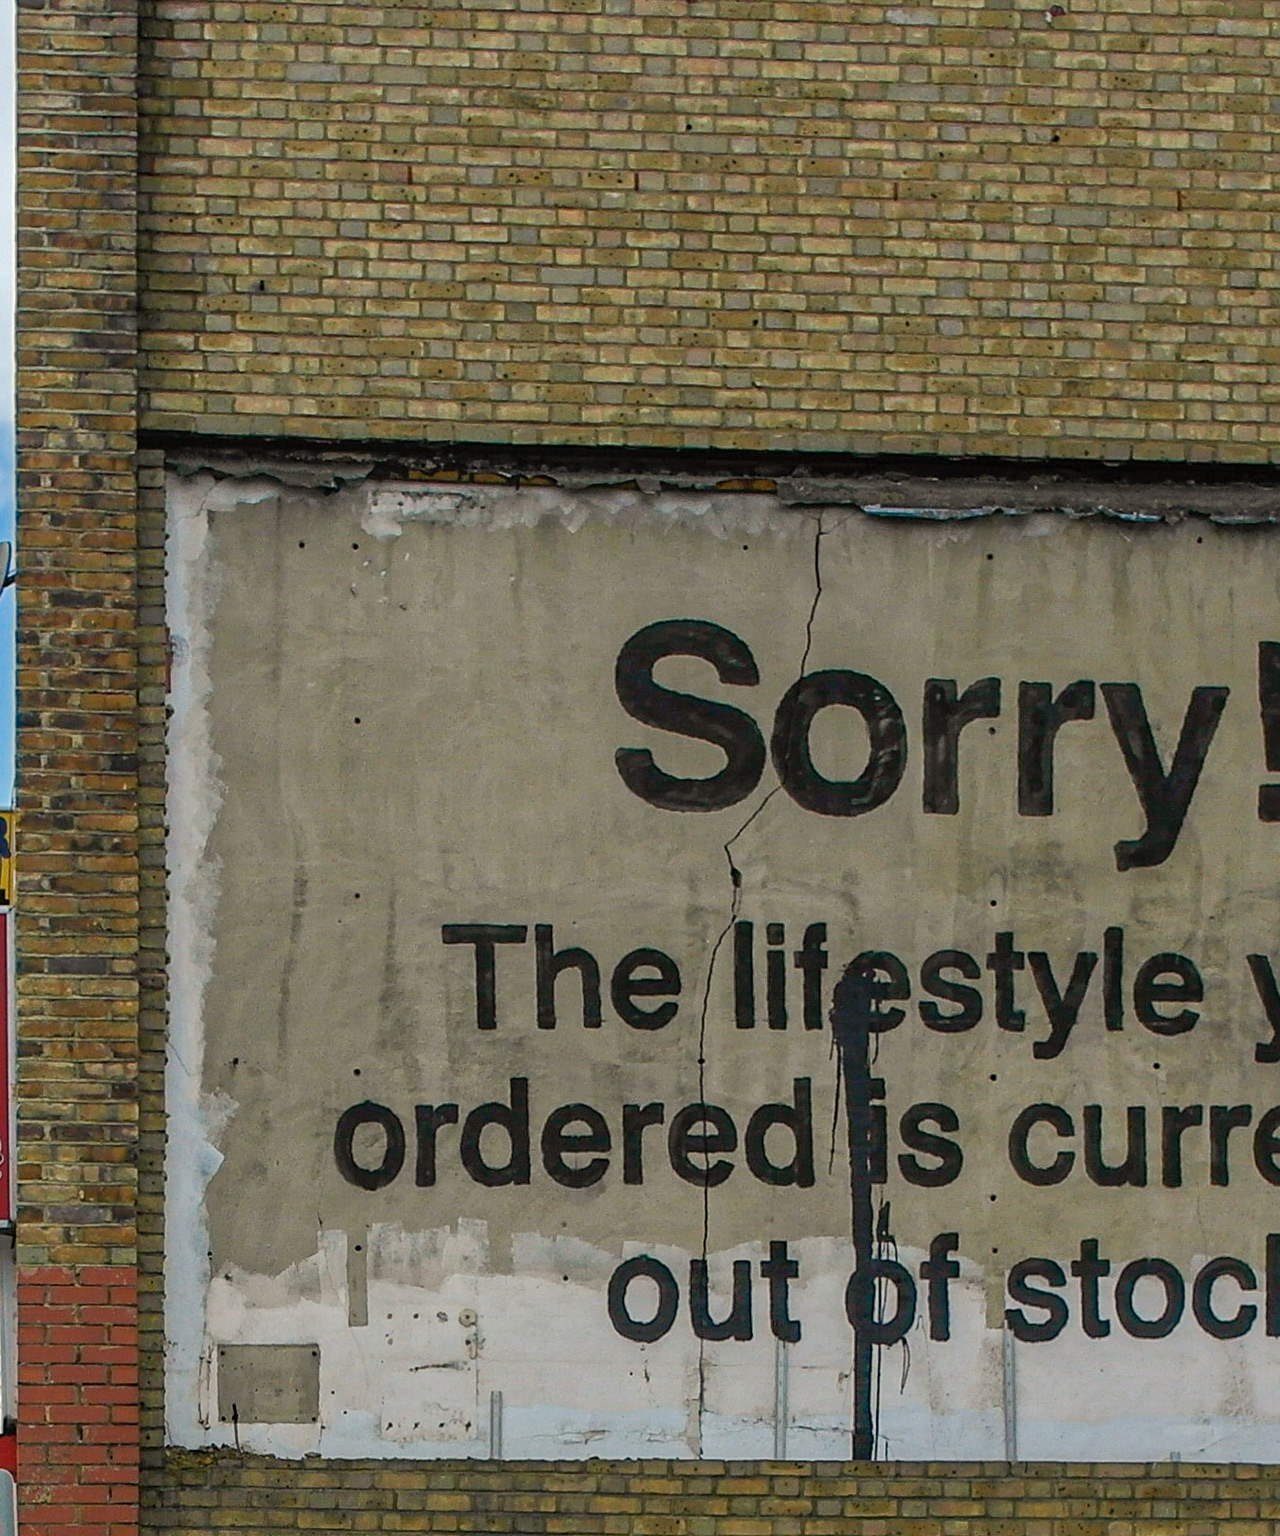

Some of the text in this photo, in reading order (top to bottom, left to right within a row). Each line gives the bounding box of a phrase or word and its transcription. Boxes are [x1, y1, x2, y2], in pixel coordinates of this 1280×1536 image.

[442, 922, 682, 1031] The
[732, 921, 1203, 1060] lifestyle
[334, 1077, 815, 1191] ordered
[869, 1078, 964, 1189] is
[607, 1240, 801, 1344] out
[846, 1232, 961, 1346] of
